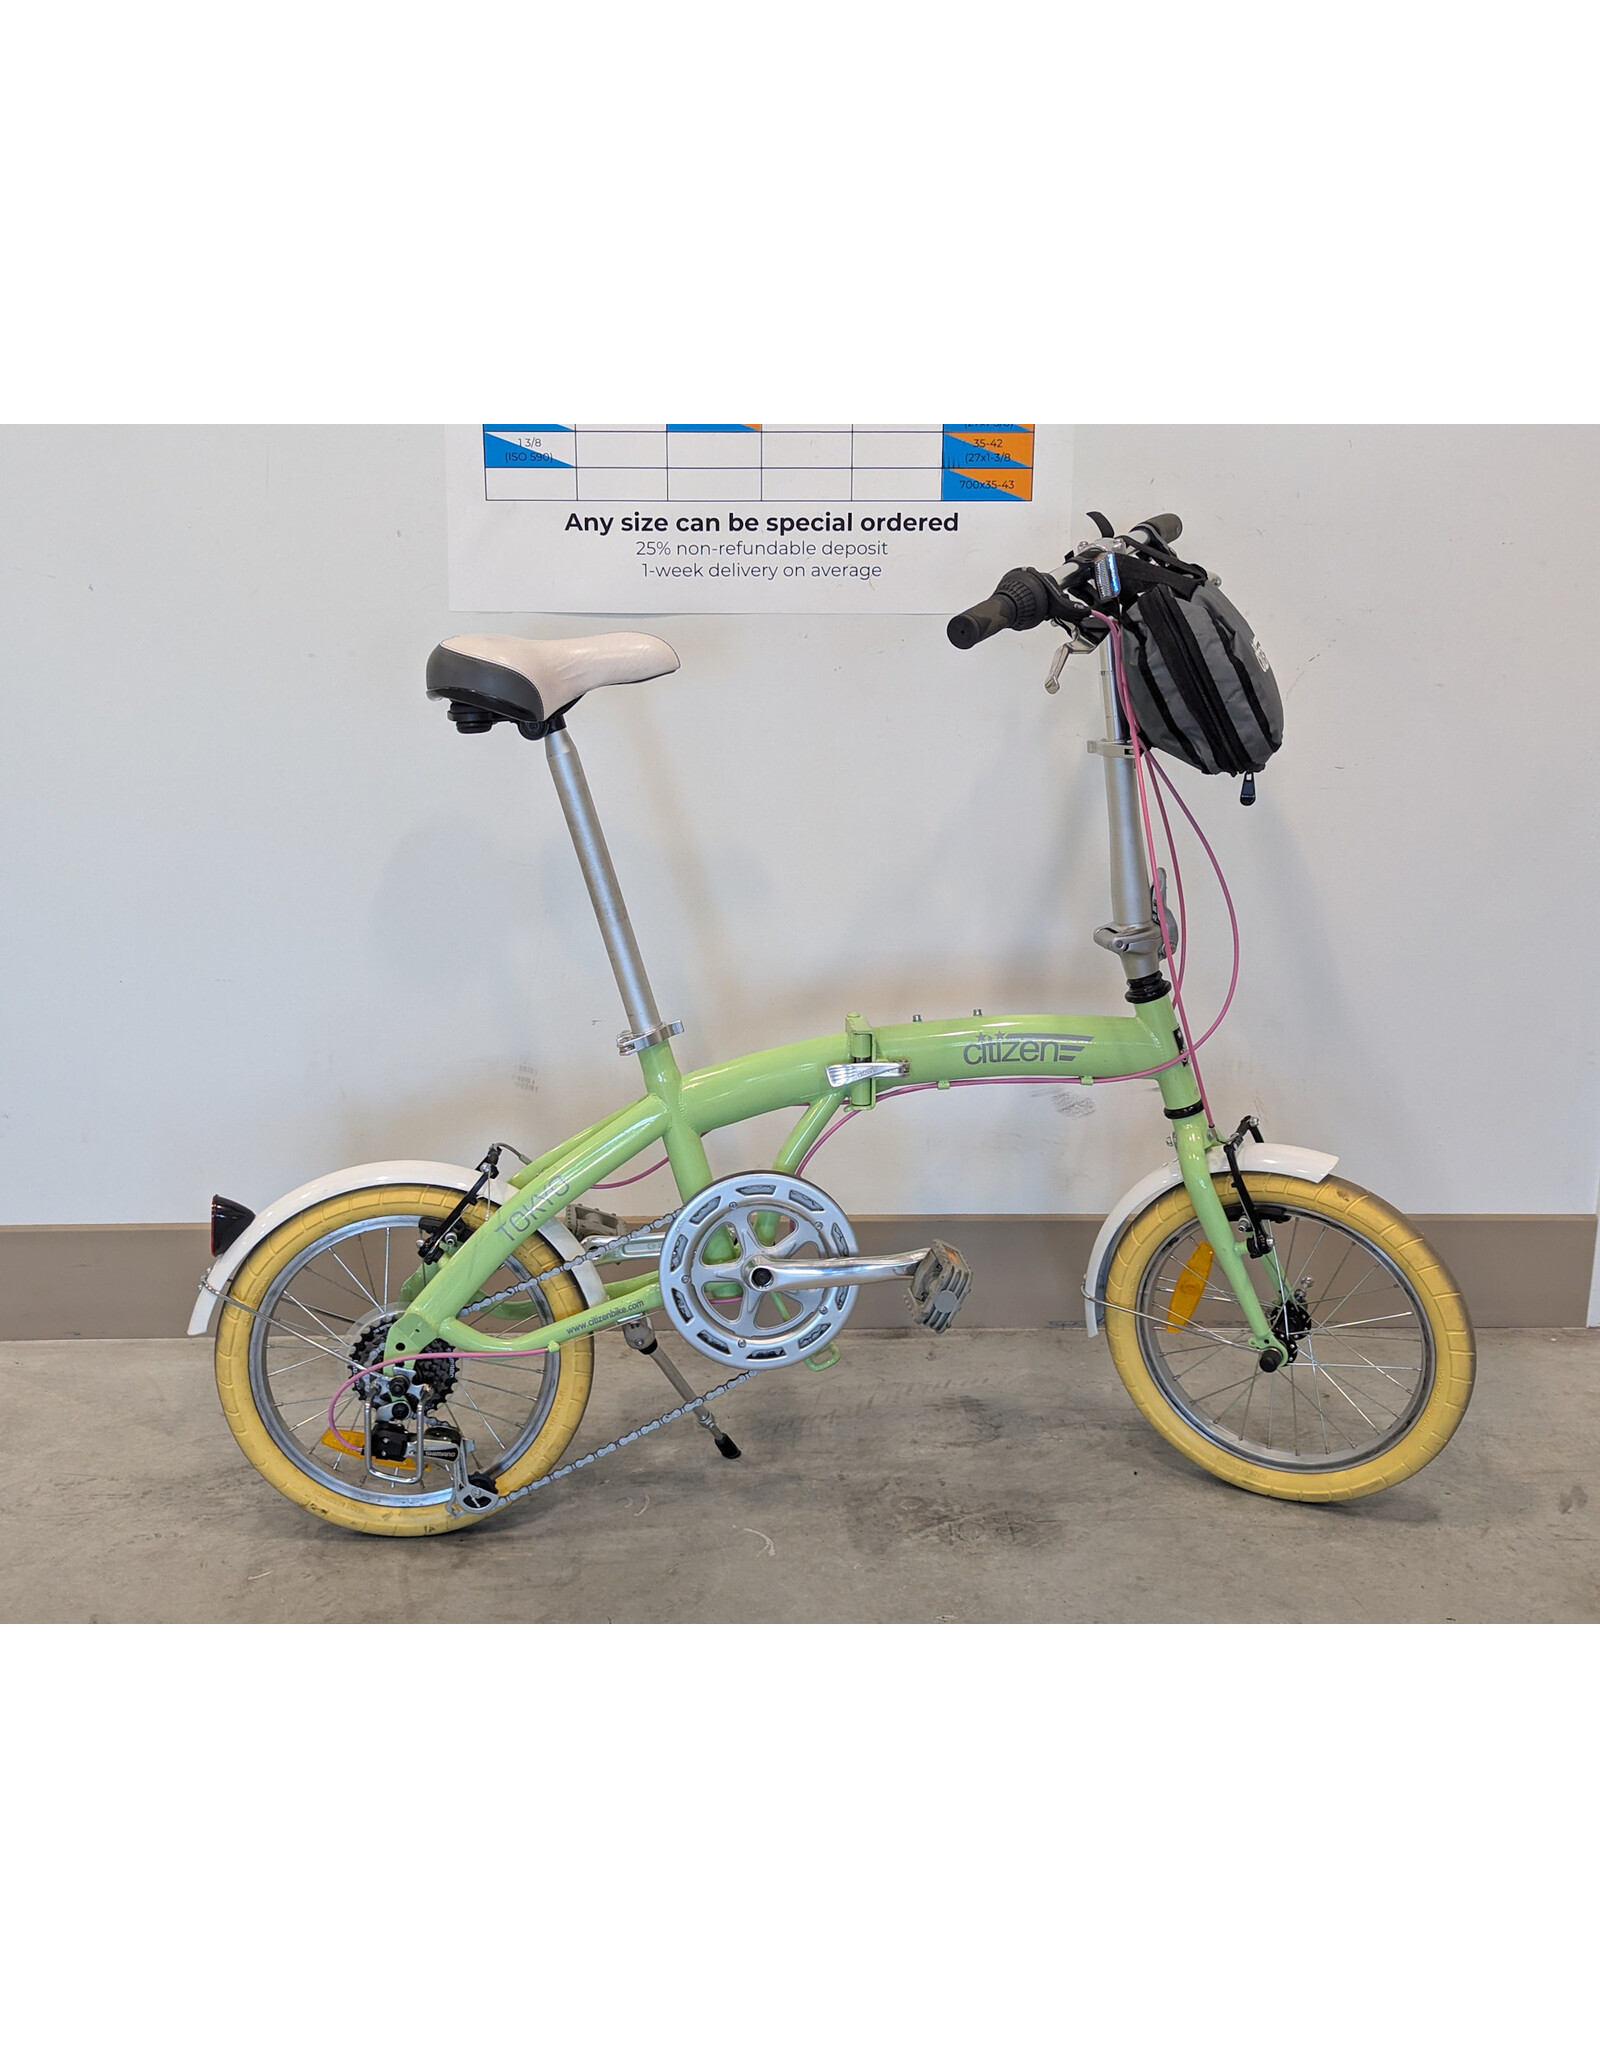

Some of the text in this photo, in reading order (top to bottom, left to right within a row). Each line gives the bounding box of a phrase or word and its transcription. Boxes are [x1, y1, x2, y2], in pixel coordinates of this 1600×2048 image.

[525, 437, 542, 448] 3/8
[973, 439, 1003, 448] 35-42
[504, 452, 553, 463] (ISO 590)
[965, 452, 1011, 464] (27x1-3/8
[960, 480, 1015, 490] 700x35-43
[564, 512, 959, 536] Any size can be special ordered
[636, 540, 889, 558] 25% non-refundable deposit
[642, 563, 882, 581] 1-week delivery on average
[963, 1031, 1059, 1065] citizen
[494, 1175, 570, 1241] TOKYO
[566, 1299, 645, 1334] www.citizenbike.com
